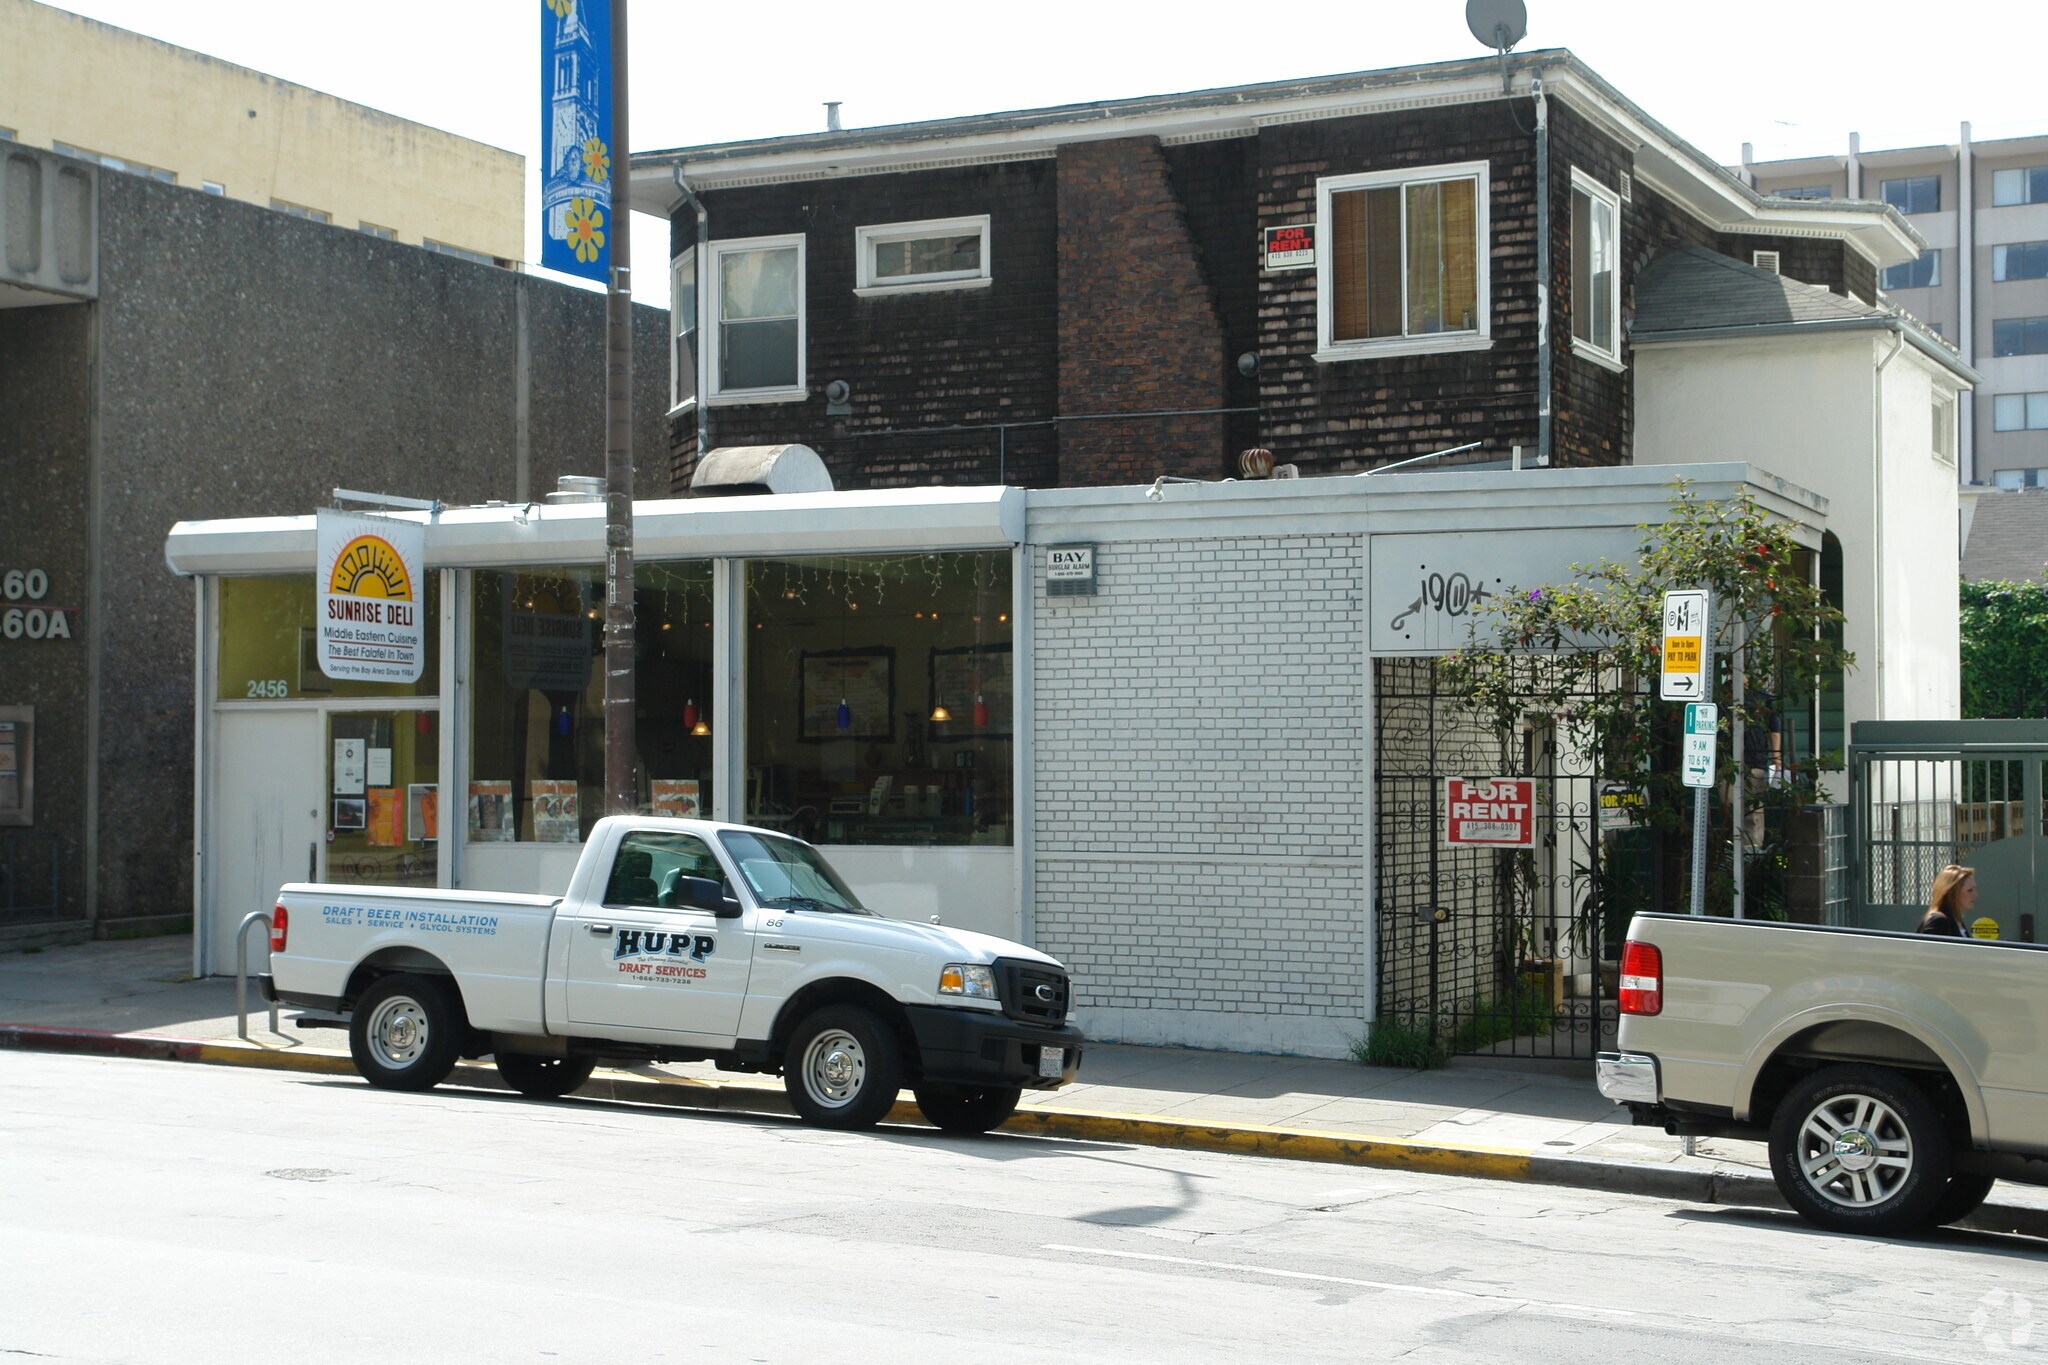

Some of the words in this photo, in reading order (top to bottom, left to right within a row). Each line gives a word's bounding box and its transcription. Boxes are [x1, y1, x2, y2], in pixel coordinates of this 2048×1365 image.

[1276, 227, 1305, 240] FOR
[1269, 238, 1312, 252] RENT
[1053, 551, 1086, 563] BAY
[1072, 562, 1090, 570] ALARM
[0, 568, 48, 600] 60
[328, 598, 382, 624] SUNRISE
[387, 604, 413, 627] DELI
[0, 608, 71, 640] 60A
[324, 626, 353, 640] Middle
[356, 629, 386, 643] Eastern
[388, 632, 418, 645] Cuisine
[328, 644, 342, 656] The
[343, 645, 359, 657] Best
[360, 646, 386, 659] Falafel
[387, 649, 395, 660] In
[397, 649, 415, 661] Town
[1667, 651, 1676, 662] PAY
[1677, 651, 1683, 662] TO
[1684, 651, 1697, 662] PARK
[330, 664, 351, 674] Serving
[351, 665, 360, 674] the
[360, 666, 371, 676] Bay
[371, 667, 385, 675] Area
[385, 668, 400, 676] Since
[247, 680, 288, 698] 2456
[1698, 740, 1707, 751] AM
[1688, 754, 1695, 765] TO
[1702, 755, 1711, 766] PM
[1461, 783, 1518, 801] FOR
[1599, 795, 1619, 808] FOR
[1453, 802, 1528, 820] RENT
[1466, 822, 1479, 830] 415
[323, 905, 364, 918] DRAFT
[367, 908, 402, 920] BEER
[405, 911, 498, 928] INSTALLATION
[766, 918, 784, 928] 86
[325, 916, 353, 925] SALES
[367, 919, 404, 929] SERVICE
[419, 923, 453, 932] GLYCOL
[455, 925, 497, 936] SYSTEMS
[614, 928, 717, 963] HUPP
[618, 962, 653, 975] DRAFT
[655, 964, 707, 979] SERVICES
